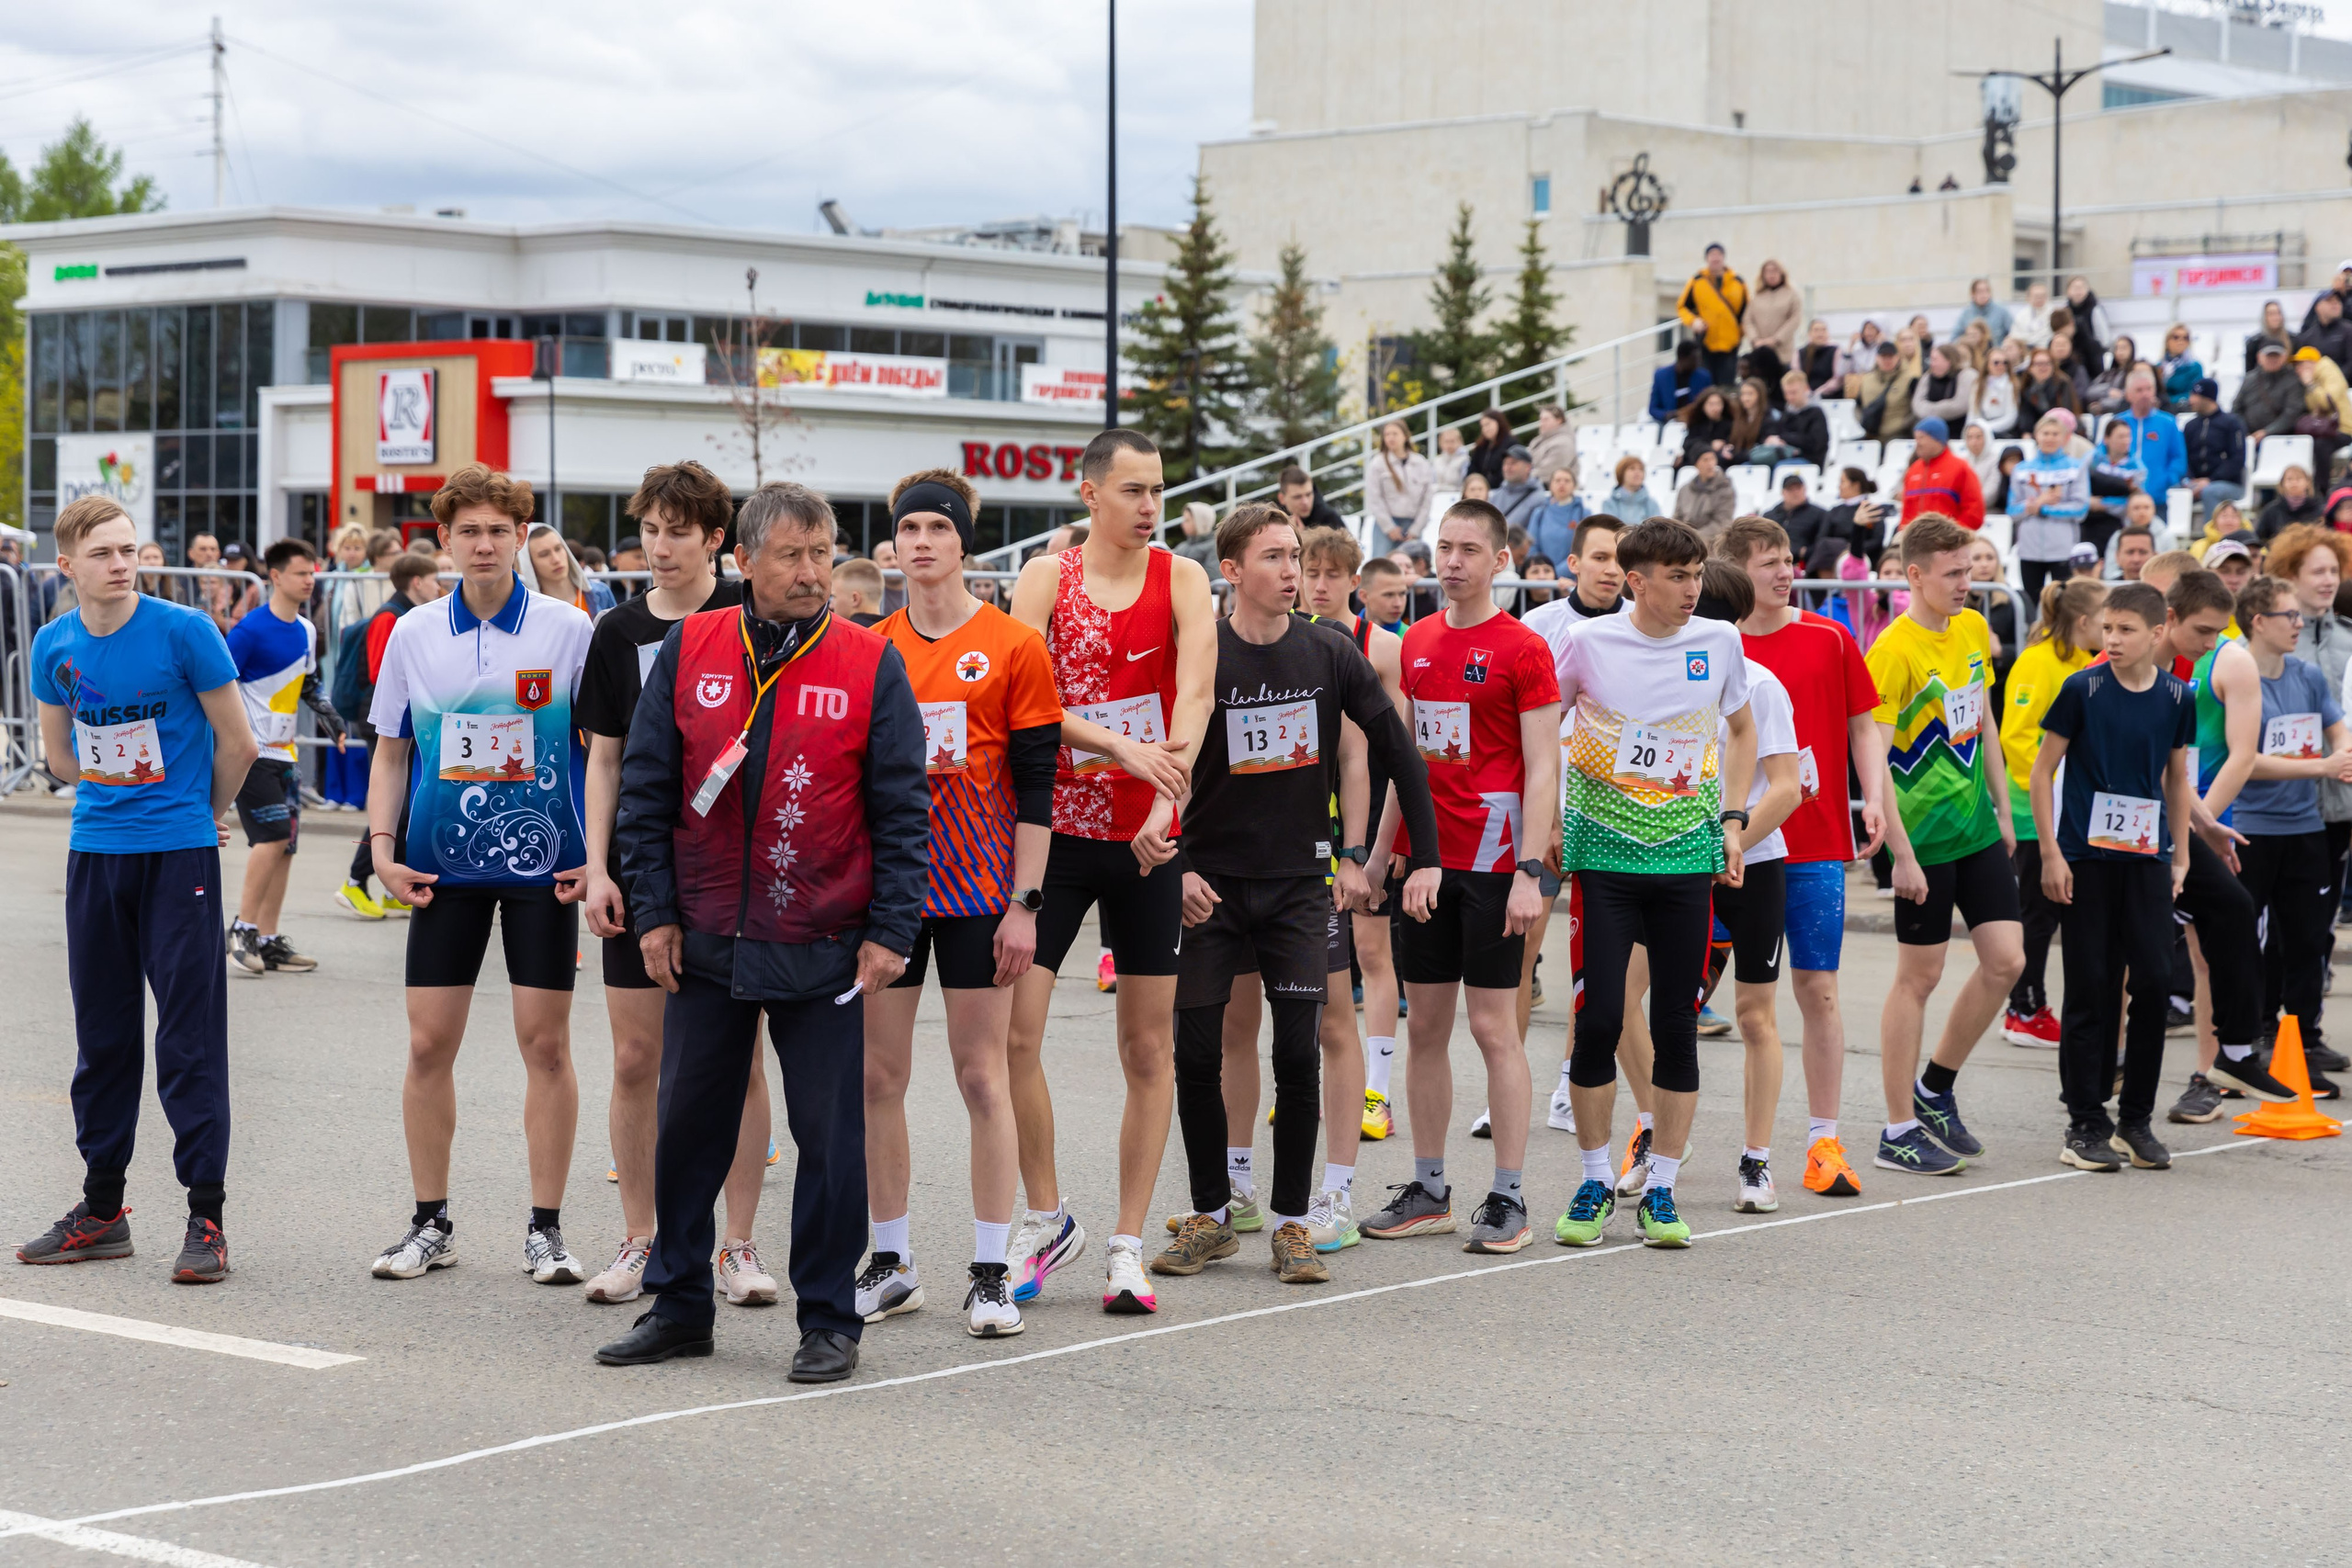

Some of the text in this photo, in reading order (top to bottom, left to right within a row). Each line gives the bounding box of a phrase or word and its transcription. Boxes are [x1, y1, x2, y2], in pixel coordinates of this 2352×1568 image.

[797, 683, 849, 720] ГТО
[1952, 700, 1974, 725] 17 2
[923, 725, 931, 741] 2
[1122, 721, 1131, 736] 2
[1243, 725, 1287, 751] 13 2
[1435, 721, 1442, 734] 2
[461, 736, 499, 758] 3 2
[2270, 731, 2286, 748] 30
[91, 743, 126, 764] 5 2
[1630, 745, 1674, 768] 20 2
[2105, 813, 2139, 831] 12 2
